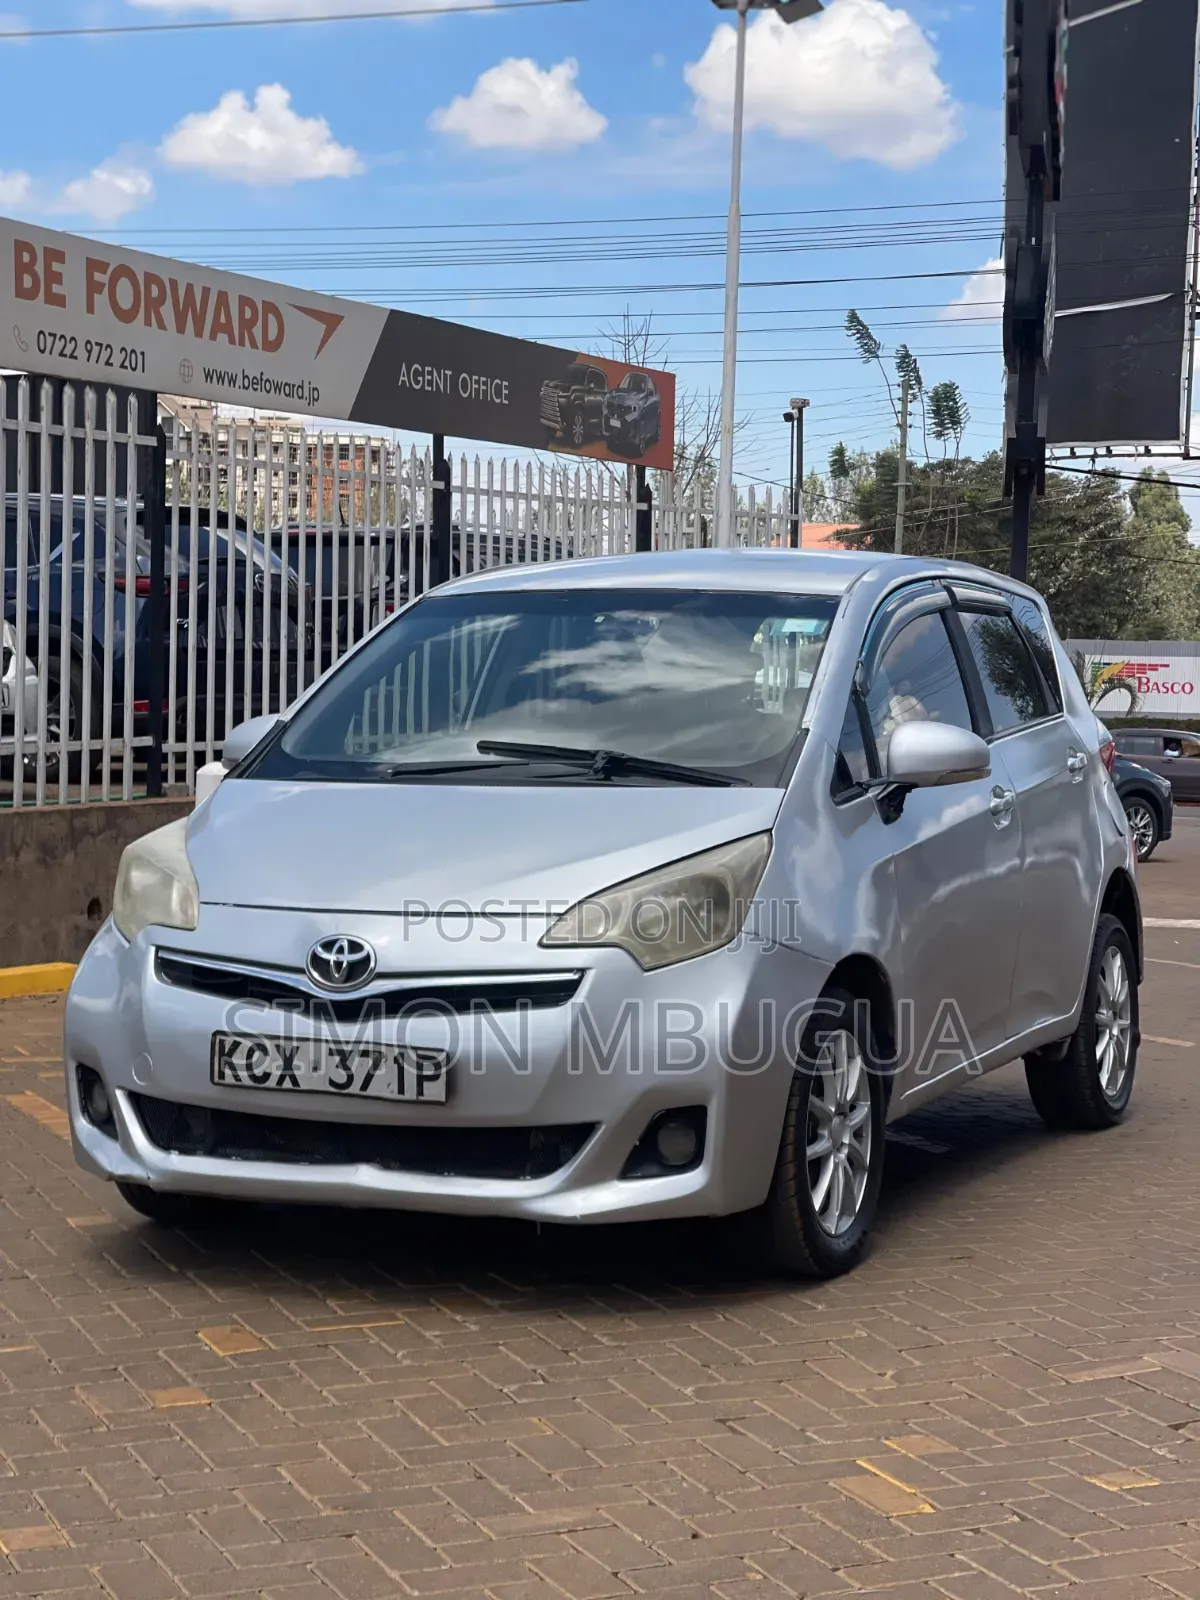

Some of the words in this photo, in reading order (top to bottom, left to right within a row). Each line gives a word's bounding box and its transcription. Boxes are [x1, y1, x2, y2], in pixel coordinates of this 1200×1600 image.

[13, 238, 67, 309] BE
[85, 256, 285, 353] FORWARD
[36, 330, 79, 361] 0722
[84, 341, 115, 368] 972
[119, 348, 147, 374] 201
[202, 366, 321, 406] www.befoward.jp
[398, 362, 453, 395] AGENT
[458, 372, 509, 405] OFFICE
[217, 1039, 300, 1088] KCX
[328, 1046, 443, 1098] 371P
